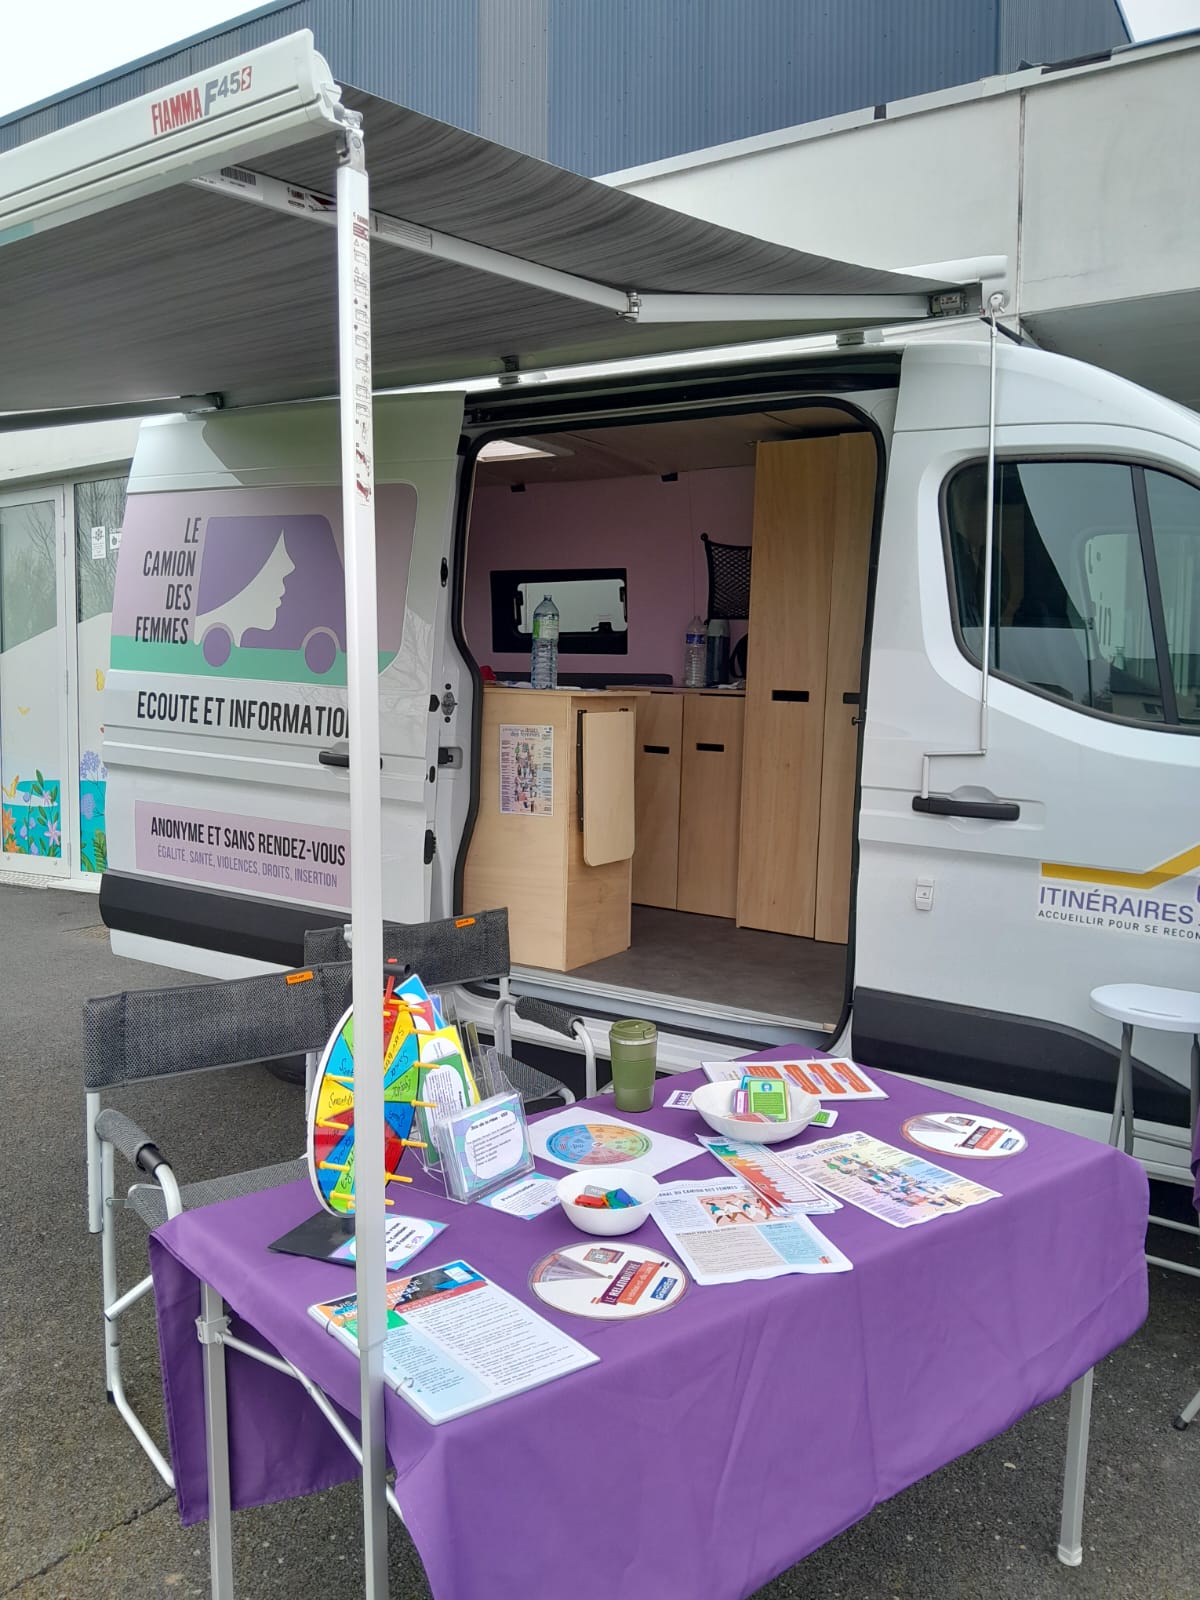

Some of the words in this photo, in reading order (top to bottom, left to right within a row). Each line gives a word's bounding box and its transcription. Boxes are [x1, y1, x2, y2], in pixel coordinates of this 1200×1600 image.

[151, 87, 203, 135] FIAMMA
[184, 517, 201, 543] LE
[143, 550, 196, 576] CAMION
[165, 583, 192, 610] DES
[135, 616, 189, 644] FEMMES
[137, 691, 199, 724] ECOUTE
[203, 696, 225, 726] ET
[151, 816, 205, 844] ANONYME
[207, 825, 221, 846] ET
[224, 828, 255, 852] SANS
[258, 833, 345, 866] RENDEZ-VOUS
[262, 862, 293, 882] DROITS,
[294, 867, 337, 888] INSERTION
[1040, 886, 1194, 925] ITINÉRAIRES
[1038, 910, 1104, 926] ACCUEILLIR
[1108, 920, 1140, 931] POUR
[1144, 924, 1159, 934] SE
